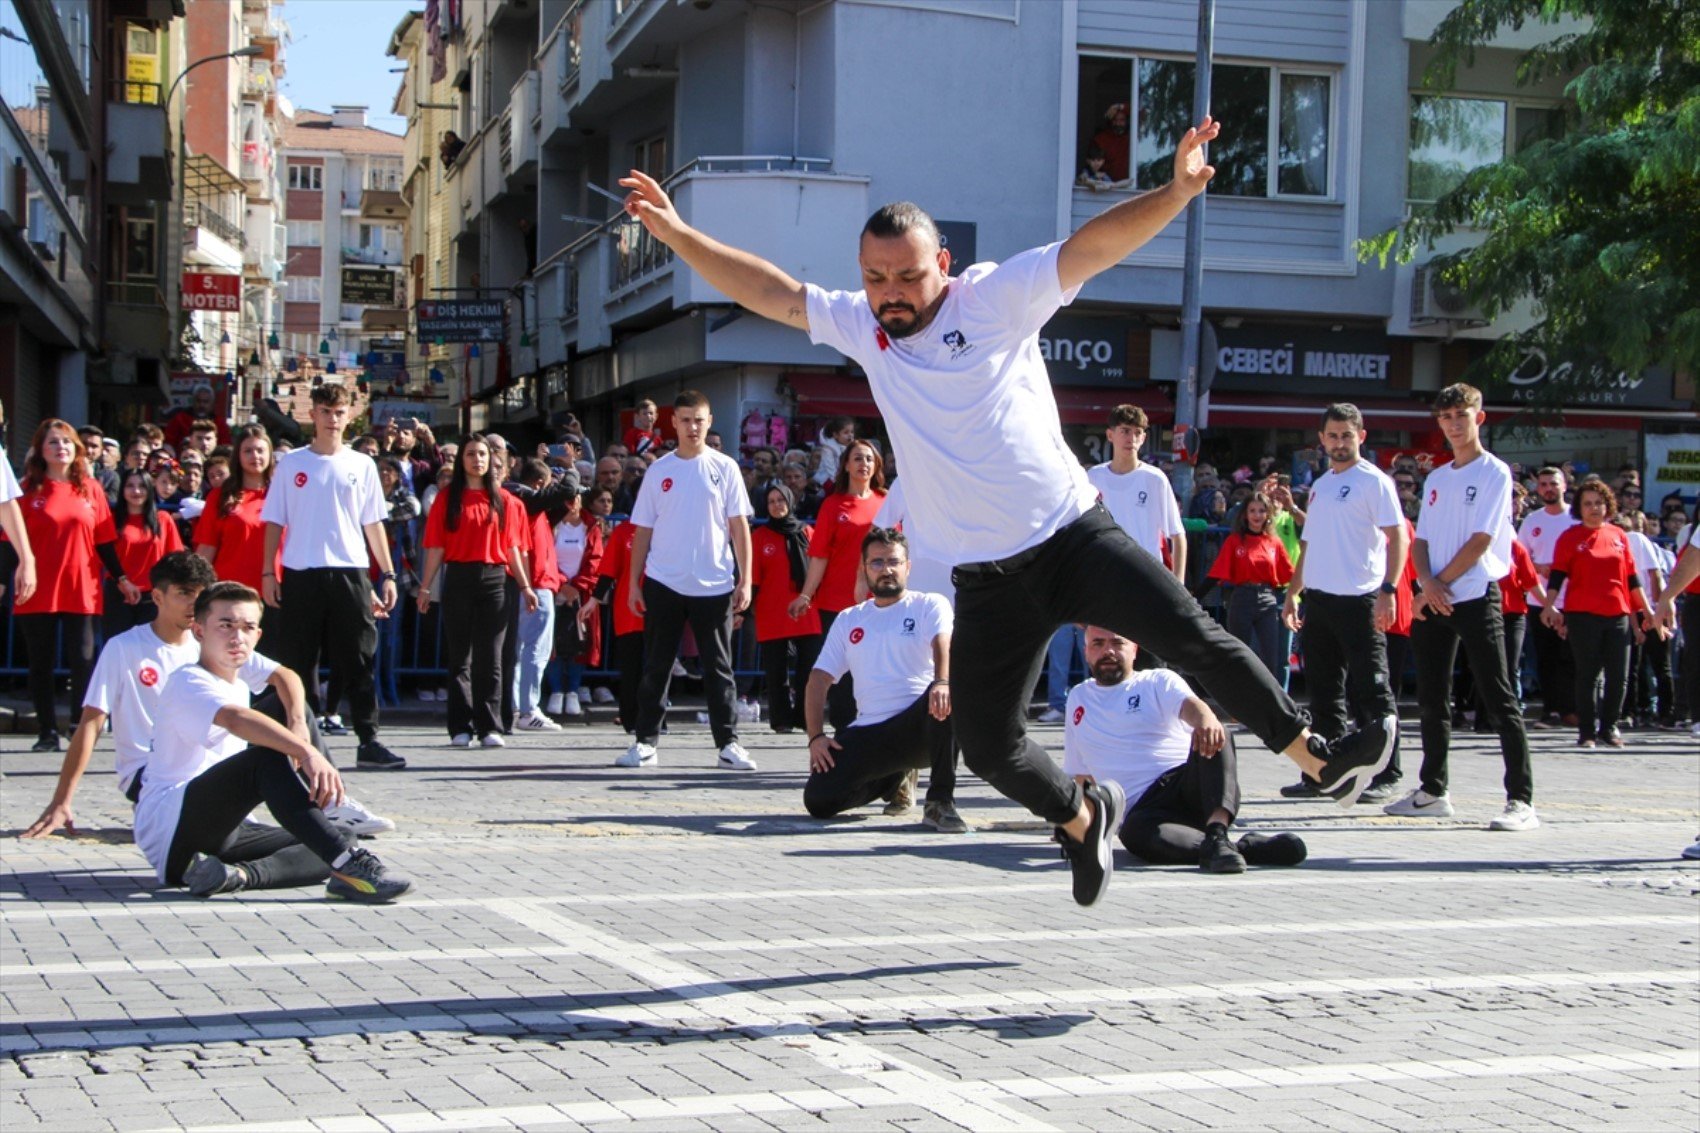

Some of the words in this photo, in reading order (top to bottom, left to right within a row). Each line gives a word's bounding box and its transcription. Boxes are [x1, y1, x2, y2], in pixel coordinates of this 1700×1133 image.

[182, 293, 237, 308] NOTER
[438, 303, 457, 318] DİŞ
[460, 303, 501, 316] HEKİMİ
[1039, 338, 1113, 370] anço
[1217, 343, 1293, 375] CEBECİ
[1304, 351, 1390, 379] MARKET
[1102, 368, 1123, 377] 1999
